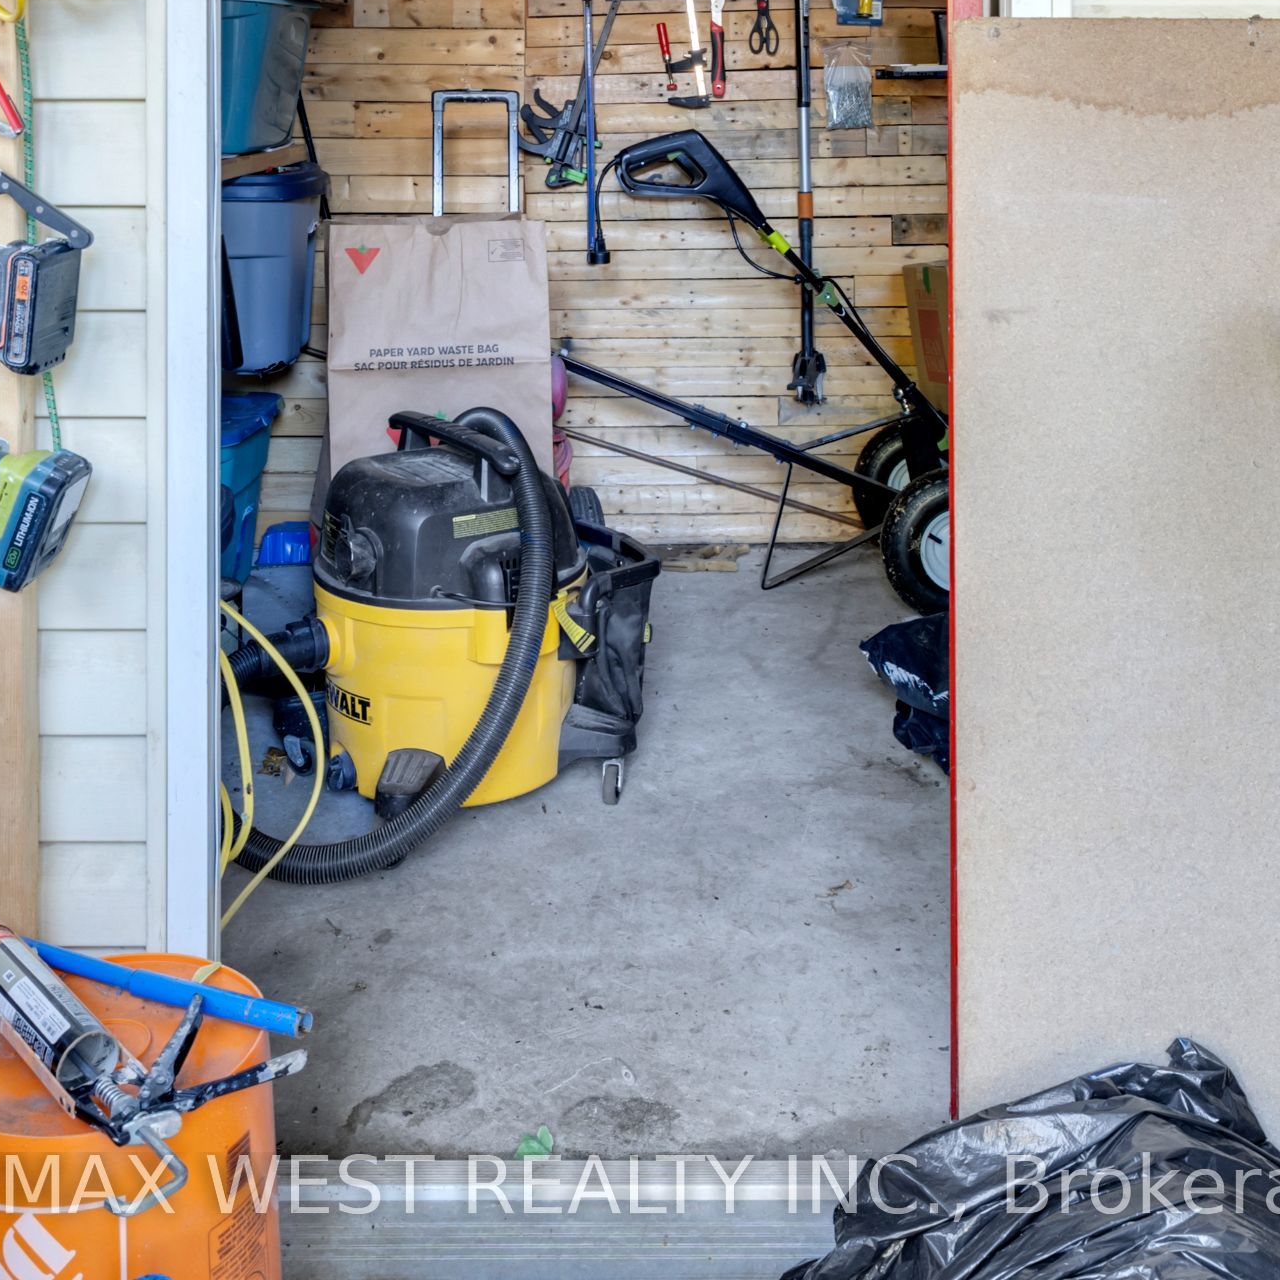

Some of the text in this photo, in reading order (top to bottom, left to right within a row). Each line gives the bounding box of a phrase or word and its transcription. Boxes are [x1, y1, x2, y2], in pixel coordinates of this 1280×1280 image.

[354, 357, 515, 371] SAC POUR RÉSIDUS DE JARDIN
[370, 344, 499, 358] PAPER YARD WASTE BAG
[14, 496, 40, 547] LITHIUM-ION
[326, 683, 371, 721] WALT
